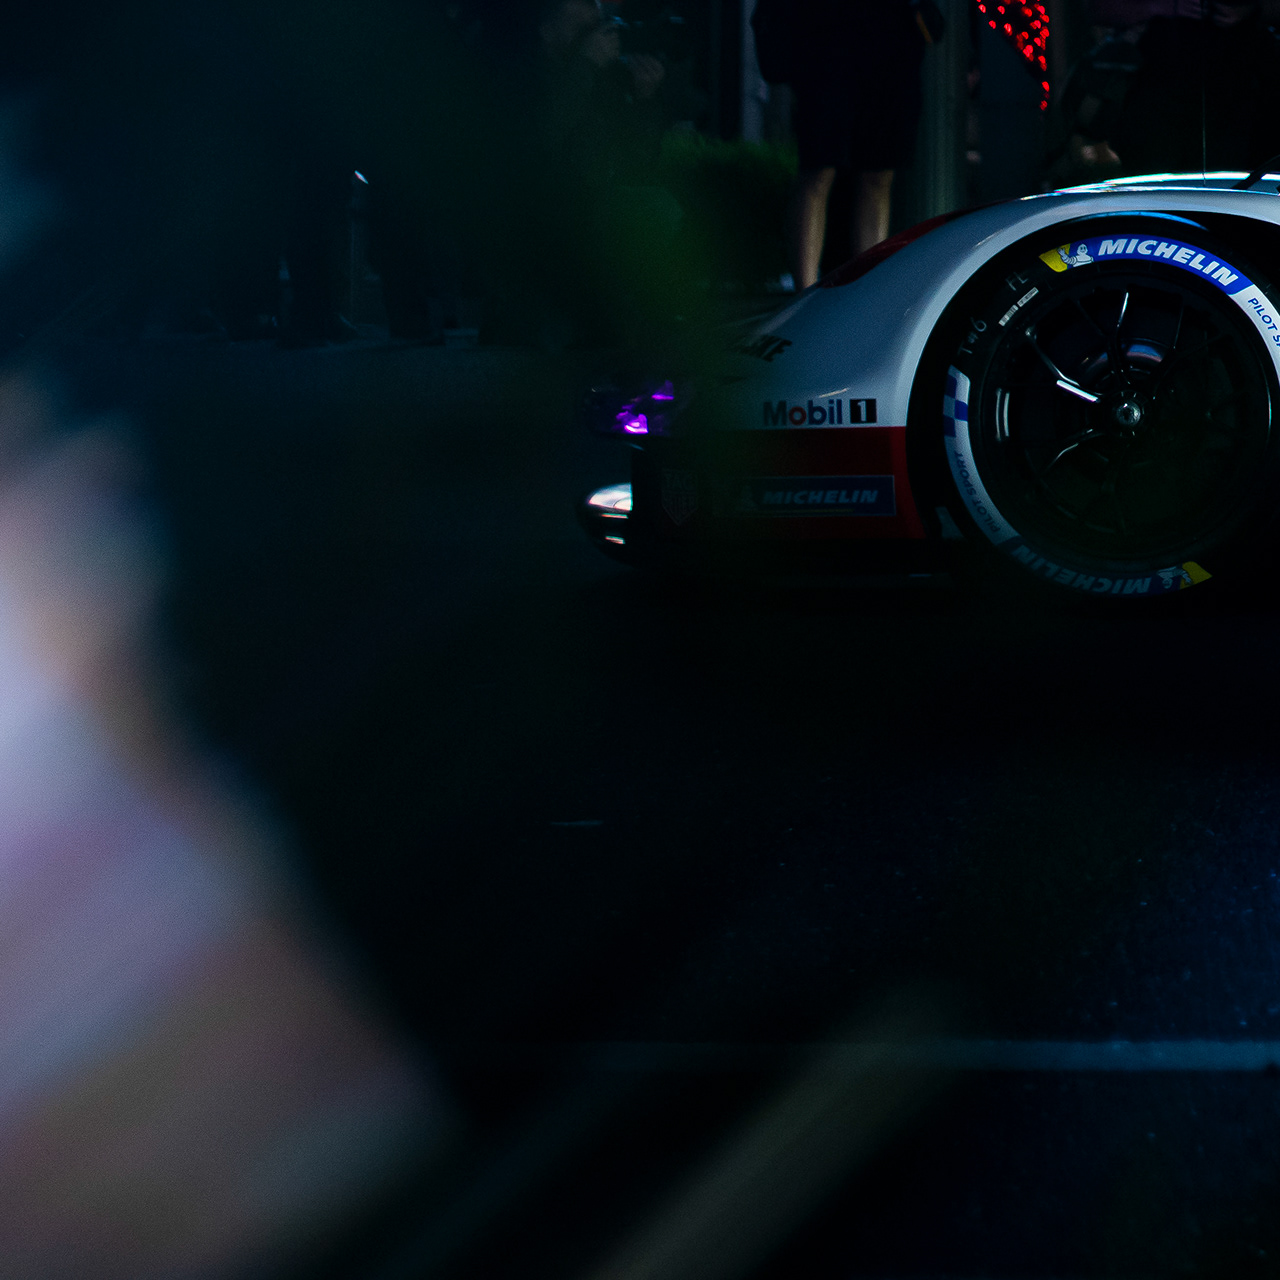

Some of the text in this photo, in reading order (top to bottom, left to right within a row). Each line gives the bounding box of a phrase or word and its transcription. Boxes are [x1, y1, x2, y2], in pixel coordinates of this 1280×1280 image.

[1097, 238, 1239, 286] MICHELIN
[1247, 297, 1277, 335] PILOT
[763, 399, 843, 425] Mobil
[954, 452, 977, 497] SPORT
[761, 489, 879, 505] MICHELIN
[1010, 544, 1152, 595] MICHELIN
